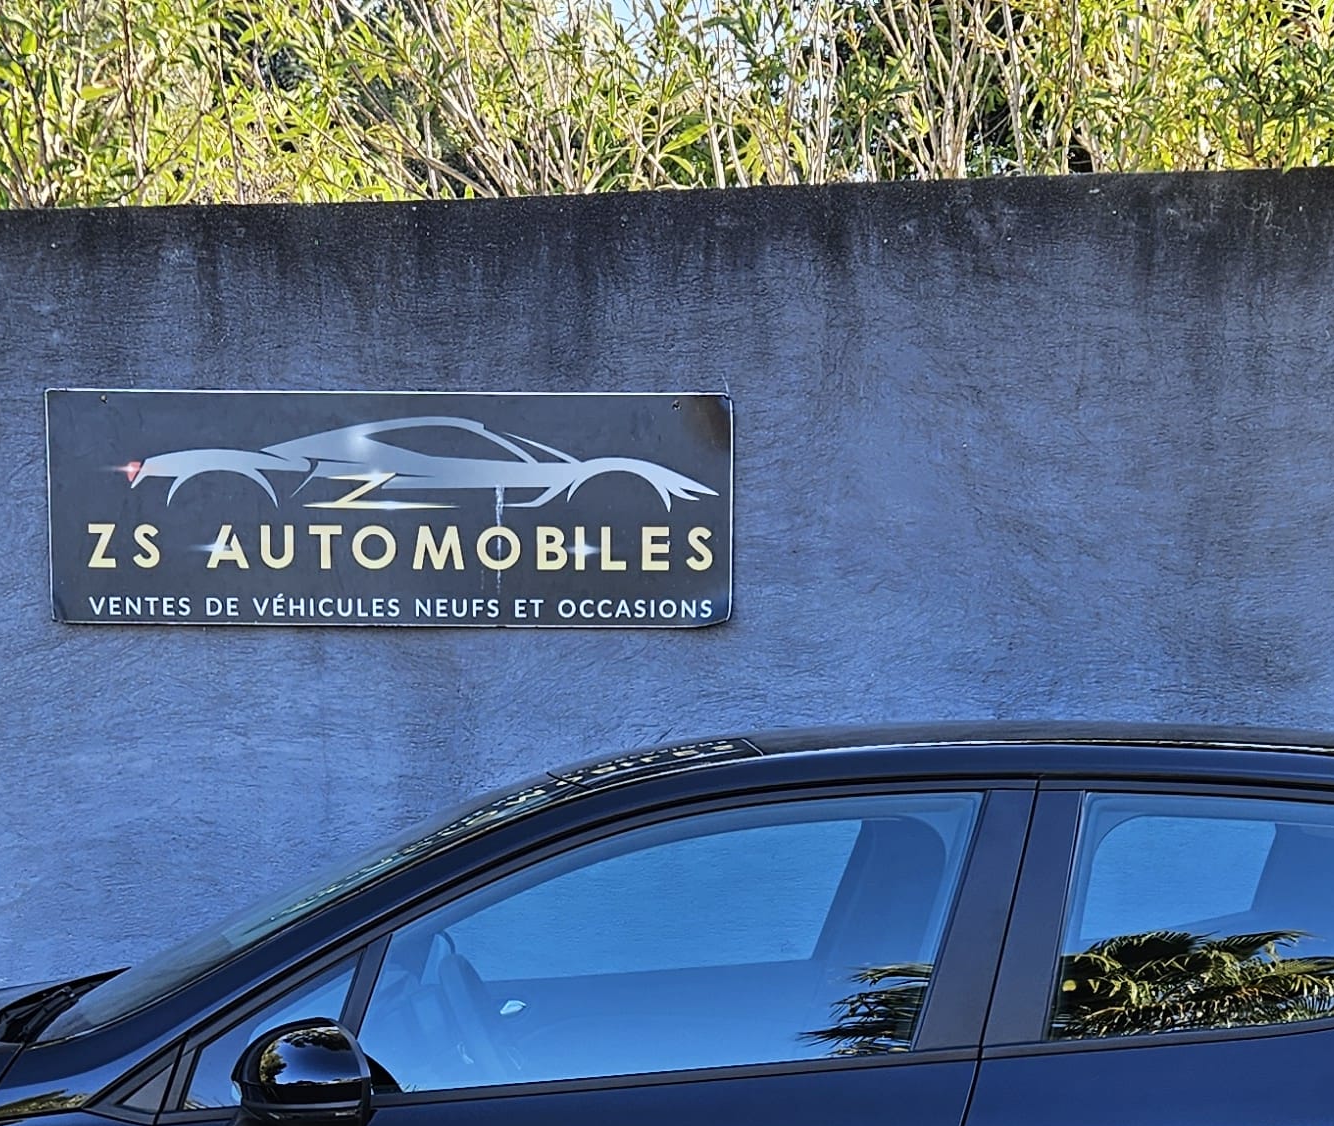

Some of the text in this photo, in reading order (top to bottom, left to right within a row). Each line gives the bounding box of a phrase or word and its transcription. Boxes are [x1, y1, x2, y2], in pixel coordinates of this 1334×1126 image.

[87, 523, 714, 571] ZS AUTOMOBILES
[88, 592, 713, 619] VENTES DE VÉHICULES NEUFS ET OCCASIONS
